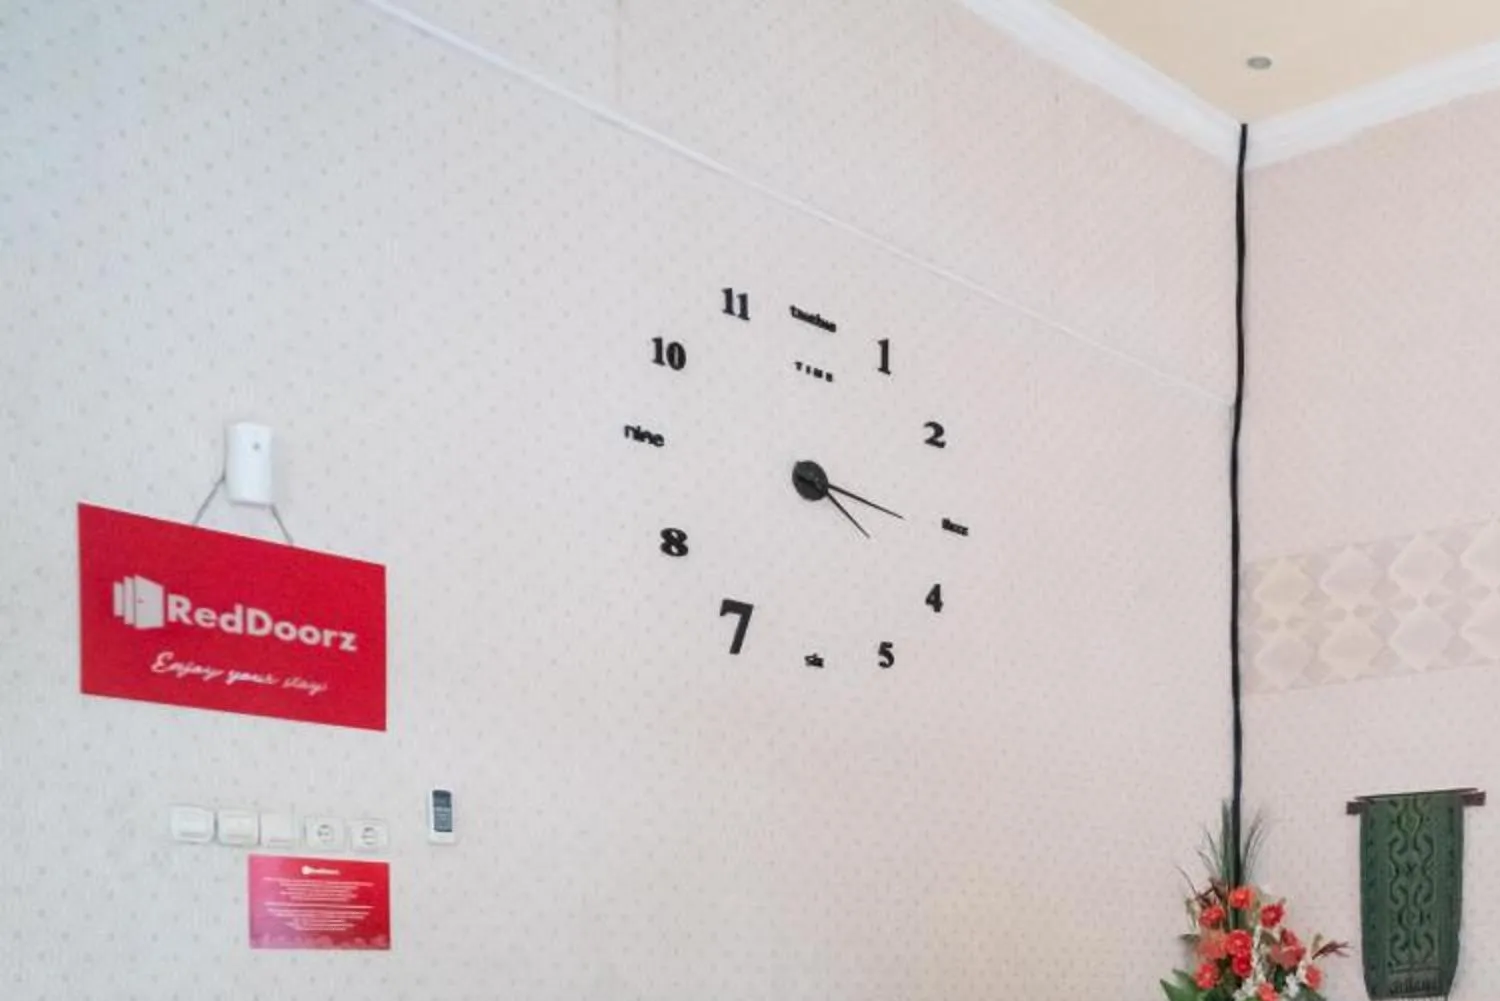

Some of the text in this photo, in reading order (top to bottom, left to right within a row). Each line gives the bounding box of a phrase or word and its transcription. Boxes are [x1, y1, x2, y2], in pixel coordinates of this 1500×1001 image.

[722, 287, 750, 321] 11
[651, 336, 687, 371] 10
[877, 338, 891, 376] 1
[624, 425, 665, 448] nine
[924, 421, 946, 449] 2
[660, 527, 689, 558] 8
[925, 583, 944, 614] 4
[167, 593, 358, 652] RedDoorz
[719, 598, 754, 655] 7
[150, 651, 224, 681] Enjoy
[227, 668, 278, 686] your
[877, 640, 895, 669] 5
